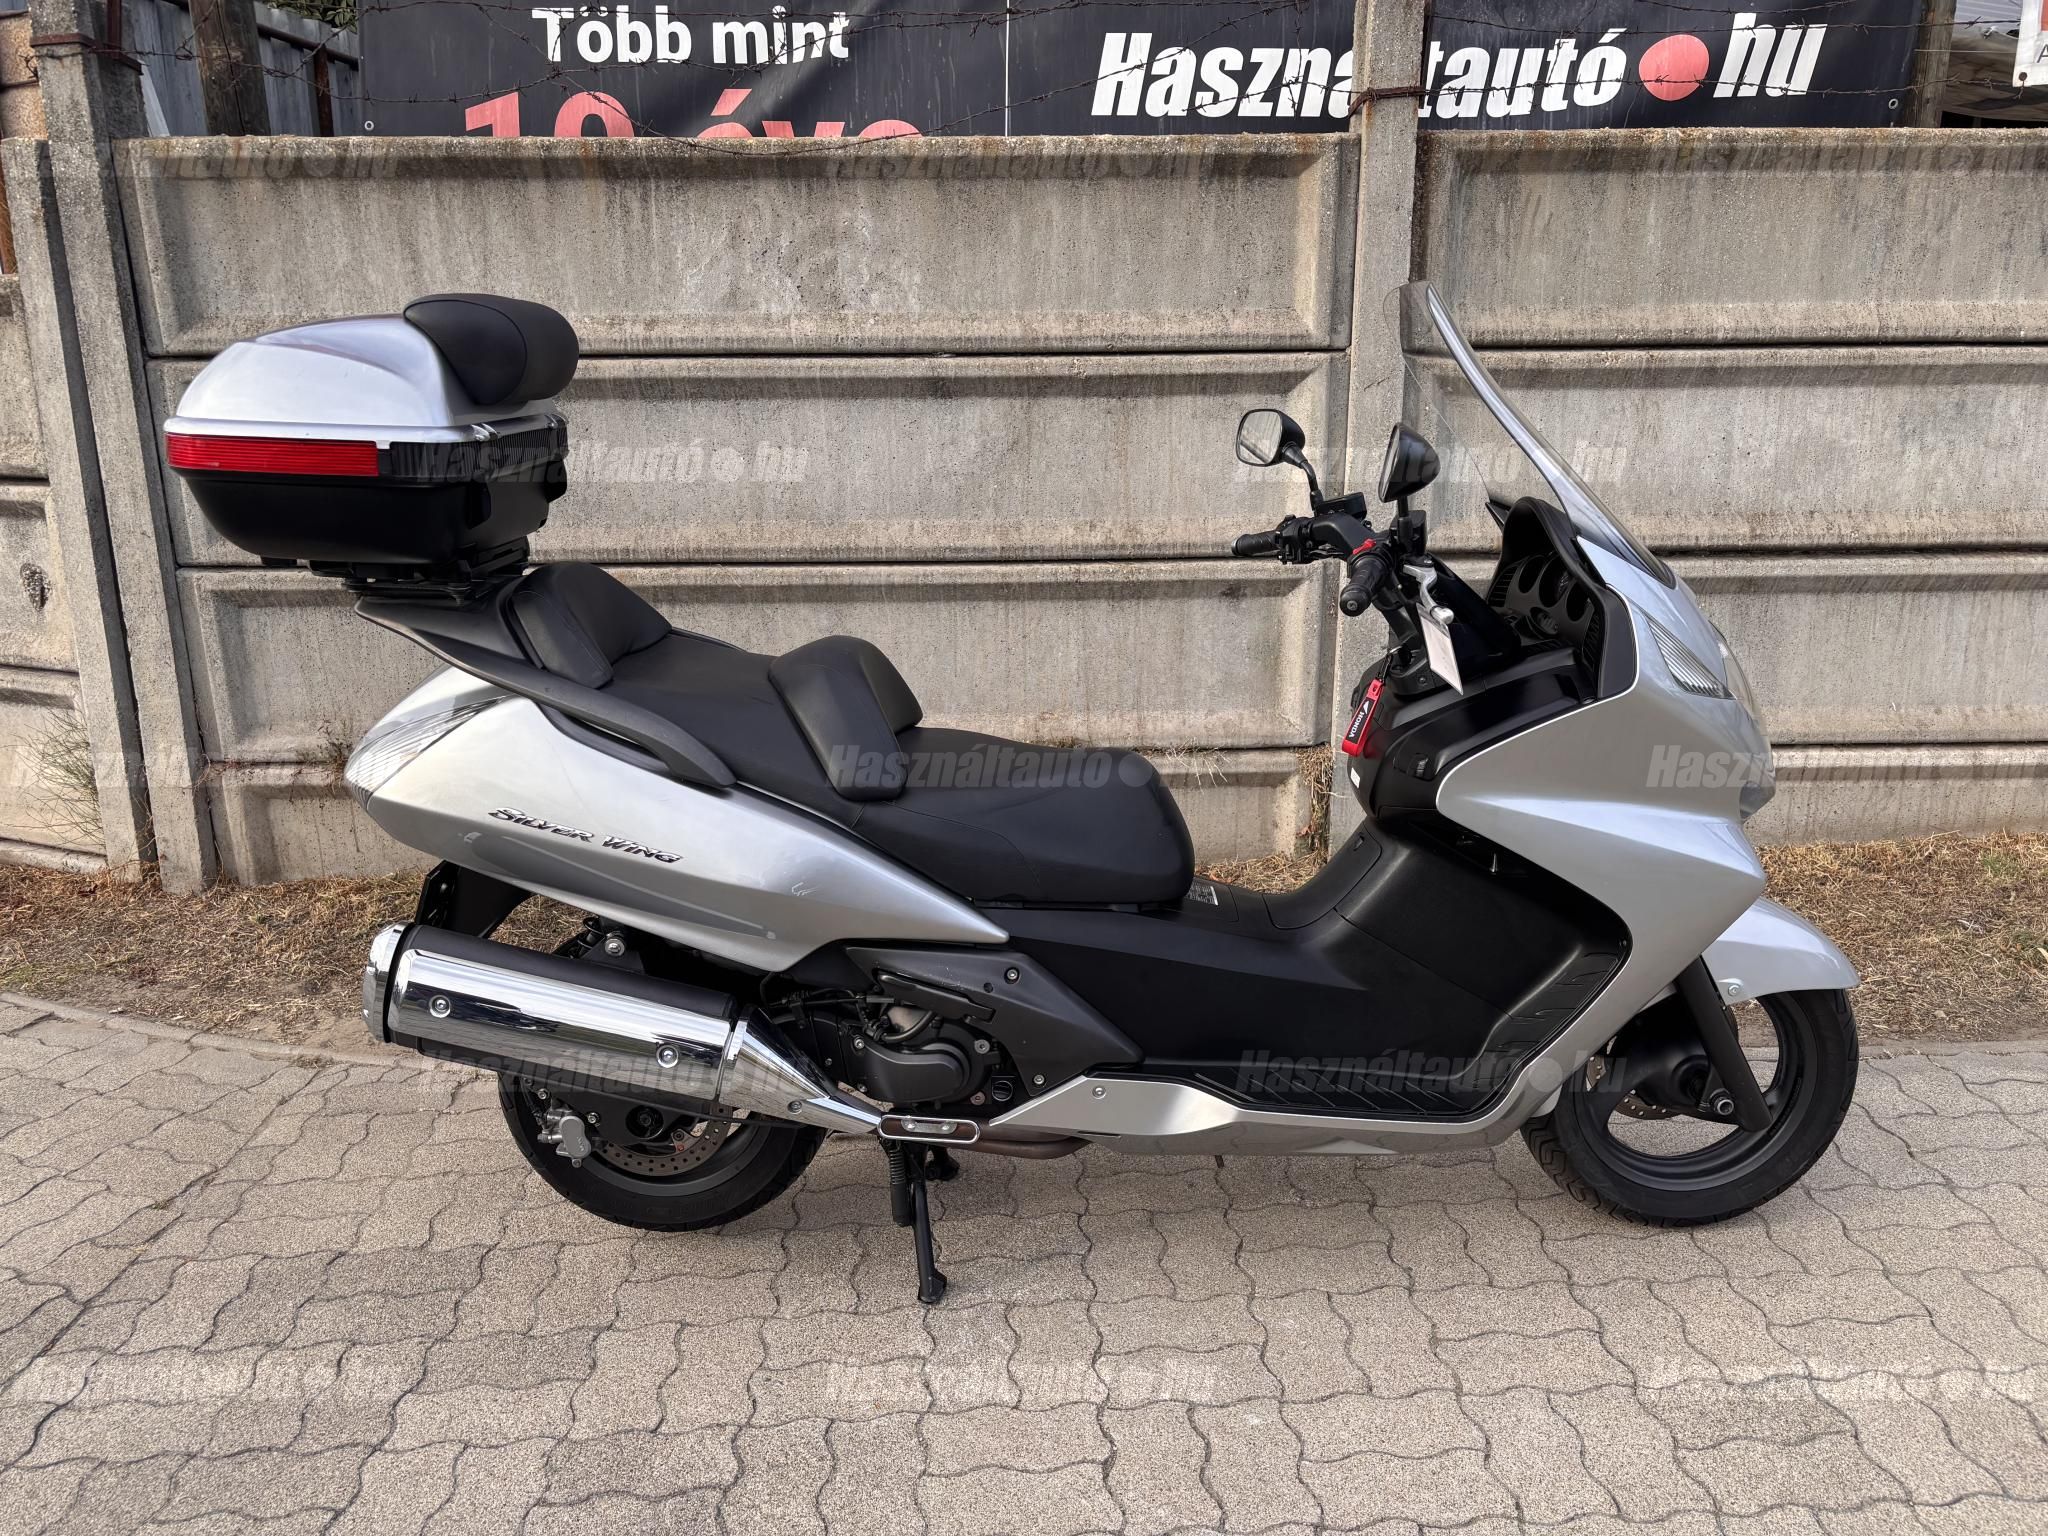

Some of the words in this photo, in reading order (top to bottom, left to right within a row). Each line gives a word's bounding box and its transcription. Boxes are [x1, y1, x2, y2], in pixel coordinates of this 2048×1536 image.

[532, 4, 692, 64] Több
[712, 5, 849, 65] mint
[1349, 711, 1365, 738] HONDA
[488, 807, 595, 843] SILVER
